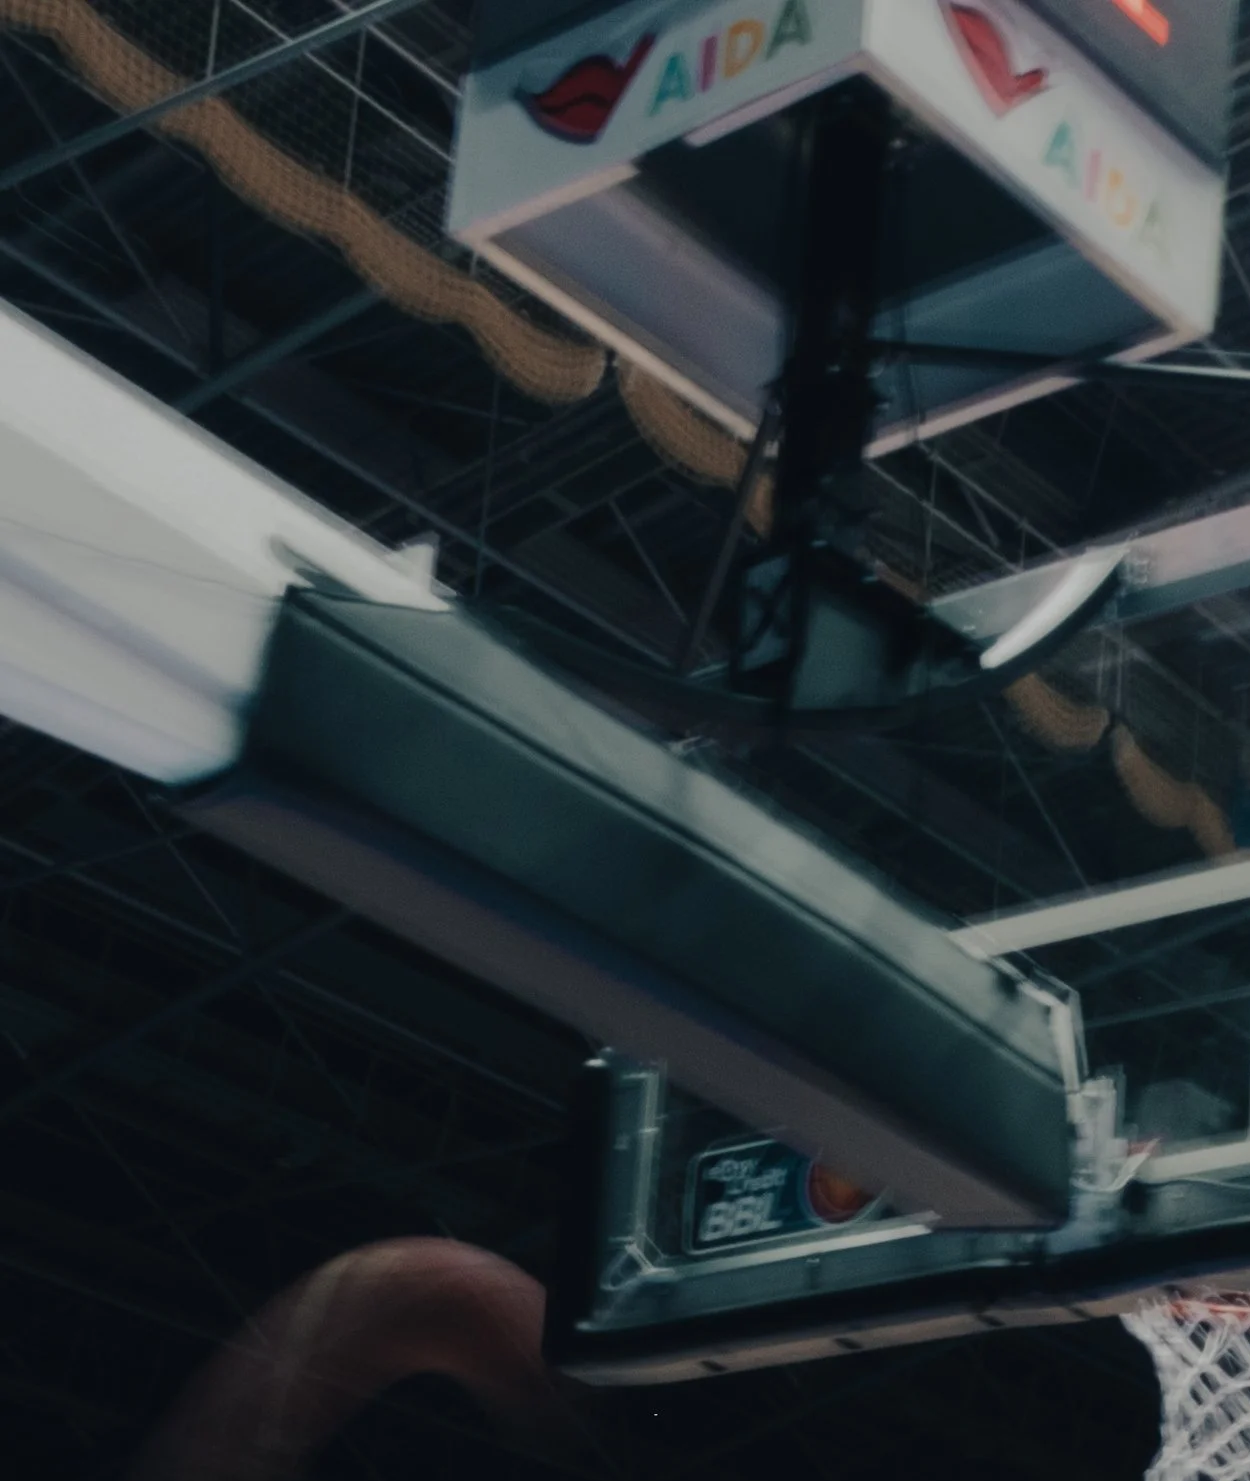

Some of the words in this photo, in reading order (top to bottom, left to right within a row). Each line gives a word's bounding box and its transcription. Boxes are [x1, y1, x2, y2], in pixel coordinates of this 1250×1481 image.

[648, 0, 814, 117] AIDA
[1040, 119, 1173, 259] AIDA
[699, 1192, 783, 1242] BBL
